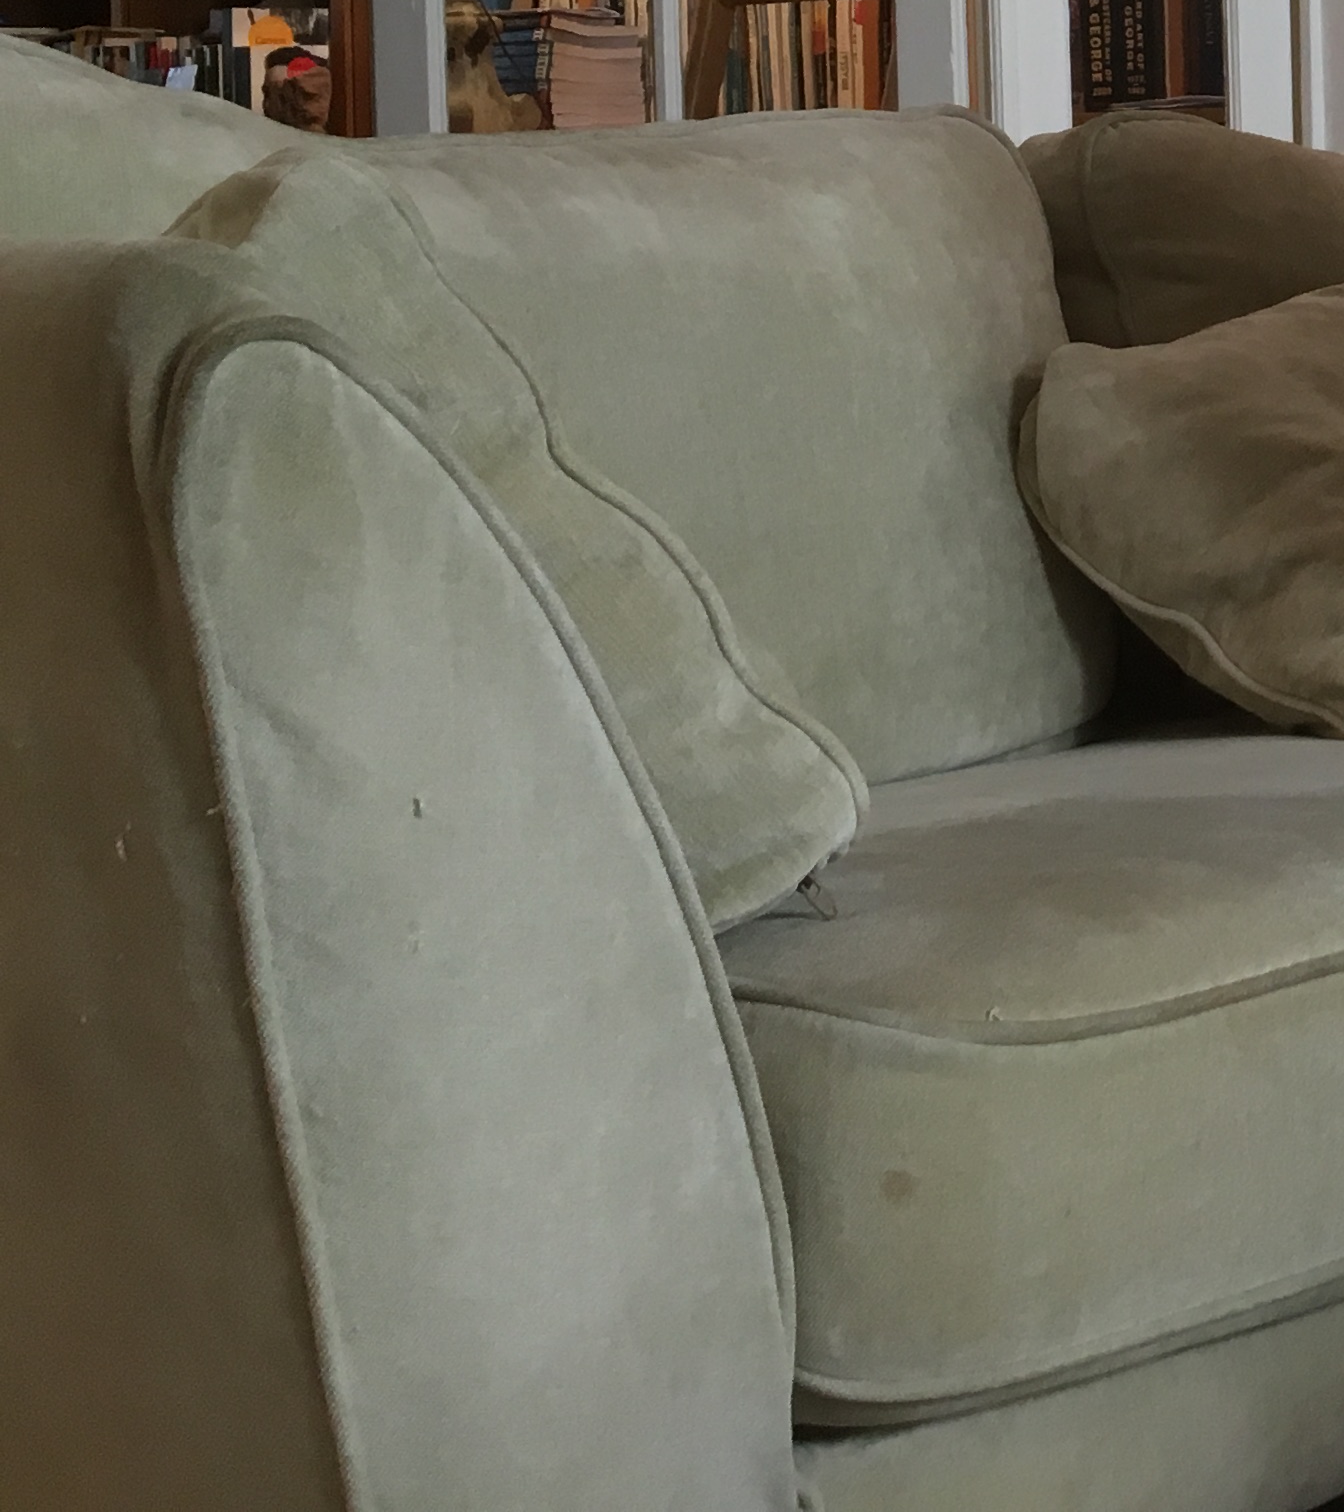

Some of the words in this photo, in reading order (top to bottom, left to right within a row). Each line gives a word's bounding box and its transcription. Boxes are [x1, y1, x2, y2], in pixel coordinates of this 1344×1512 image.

[1090, 13, 1102, 82] GEORGE
[1125, 6, 1134, 71] GEORGE
[1136, 24, 1144, 48] ART
[1137, 53, 1145, 69] OF
[1104, 69, 1112, 82] OF
